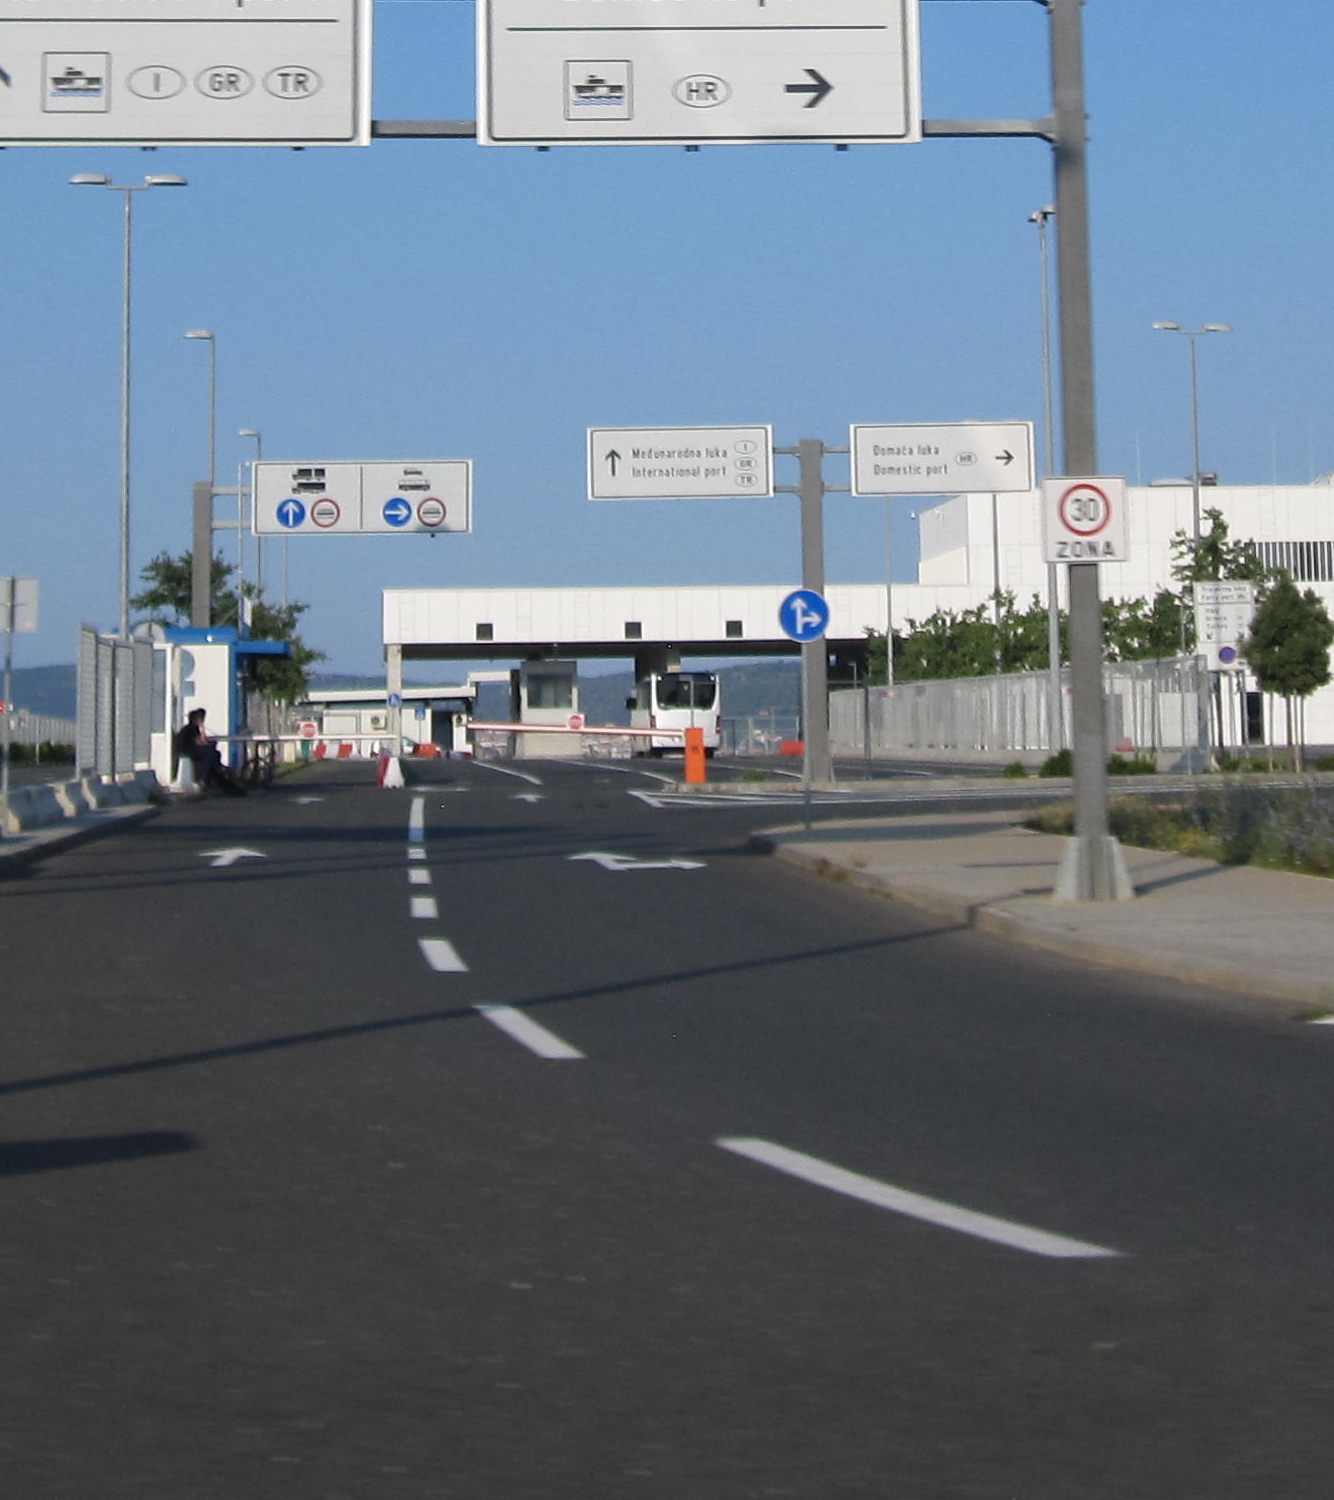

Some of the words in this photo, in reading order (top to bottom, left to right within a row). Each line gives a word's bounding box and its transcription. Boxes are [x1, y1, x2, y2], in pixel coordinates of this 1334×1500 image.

[208, 73, 242, 93] GR
[277, 72, 310, 93] TR
[684, 81, 719, 102] HR
[631, 465, 701, 478] International
[704, 465, 728, 479] port
[873, 463, 922, 476] Domestic
[925, 464, 949, 477] port
[1070, 498, 1100, 522] 30
[1055, 540, 1116, 559] ZONA
